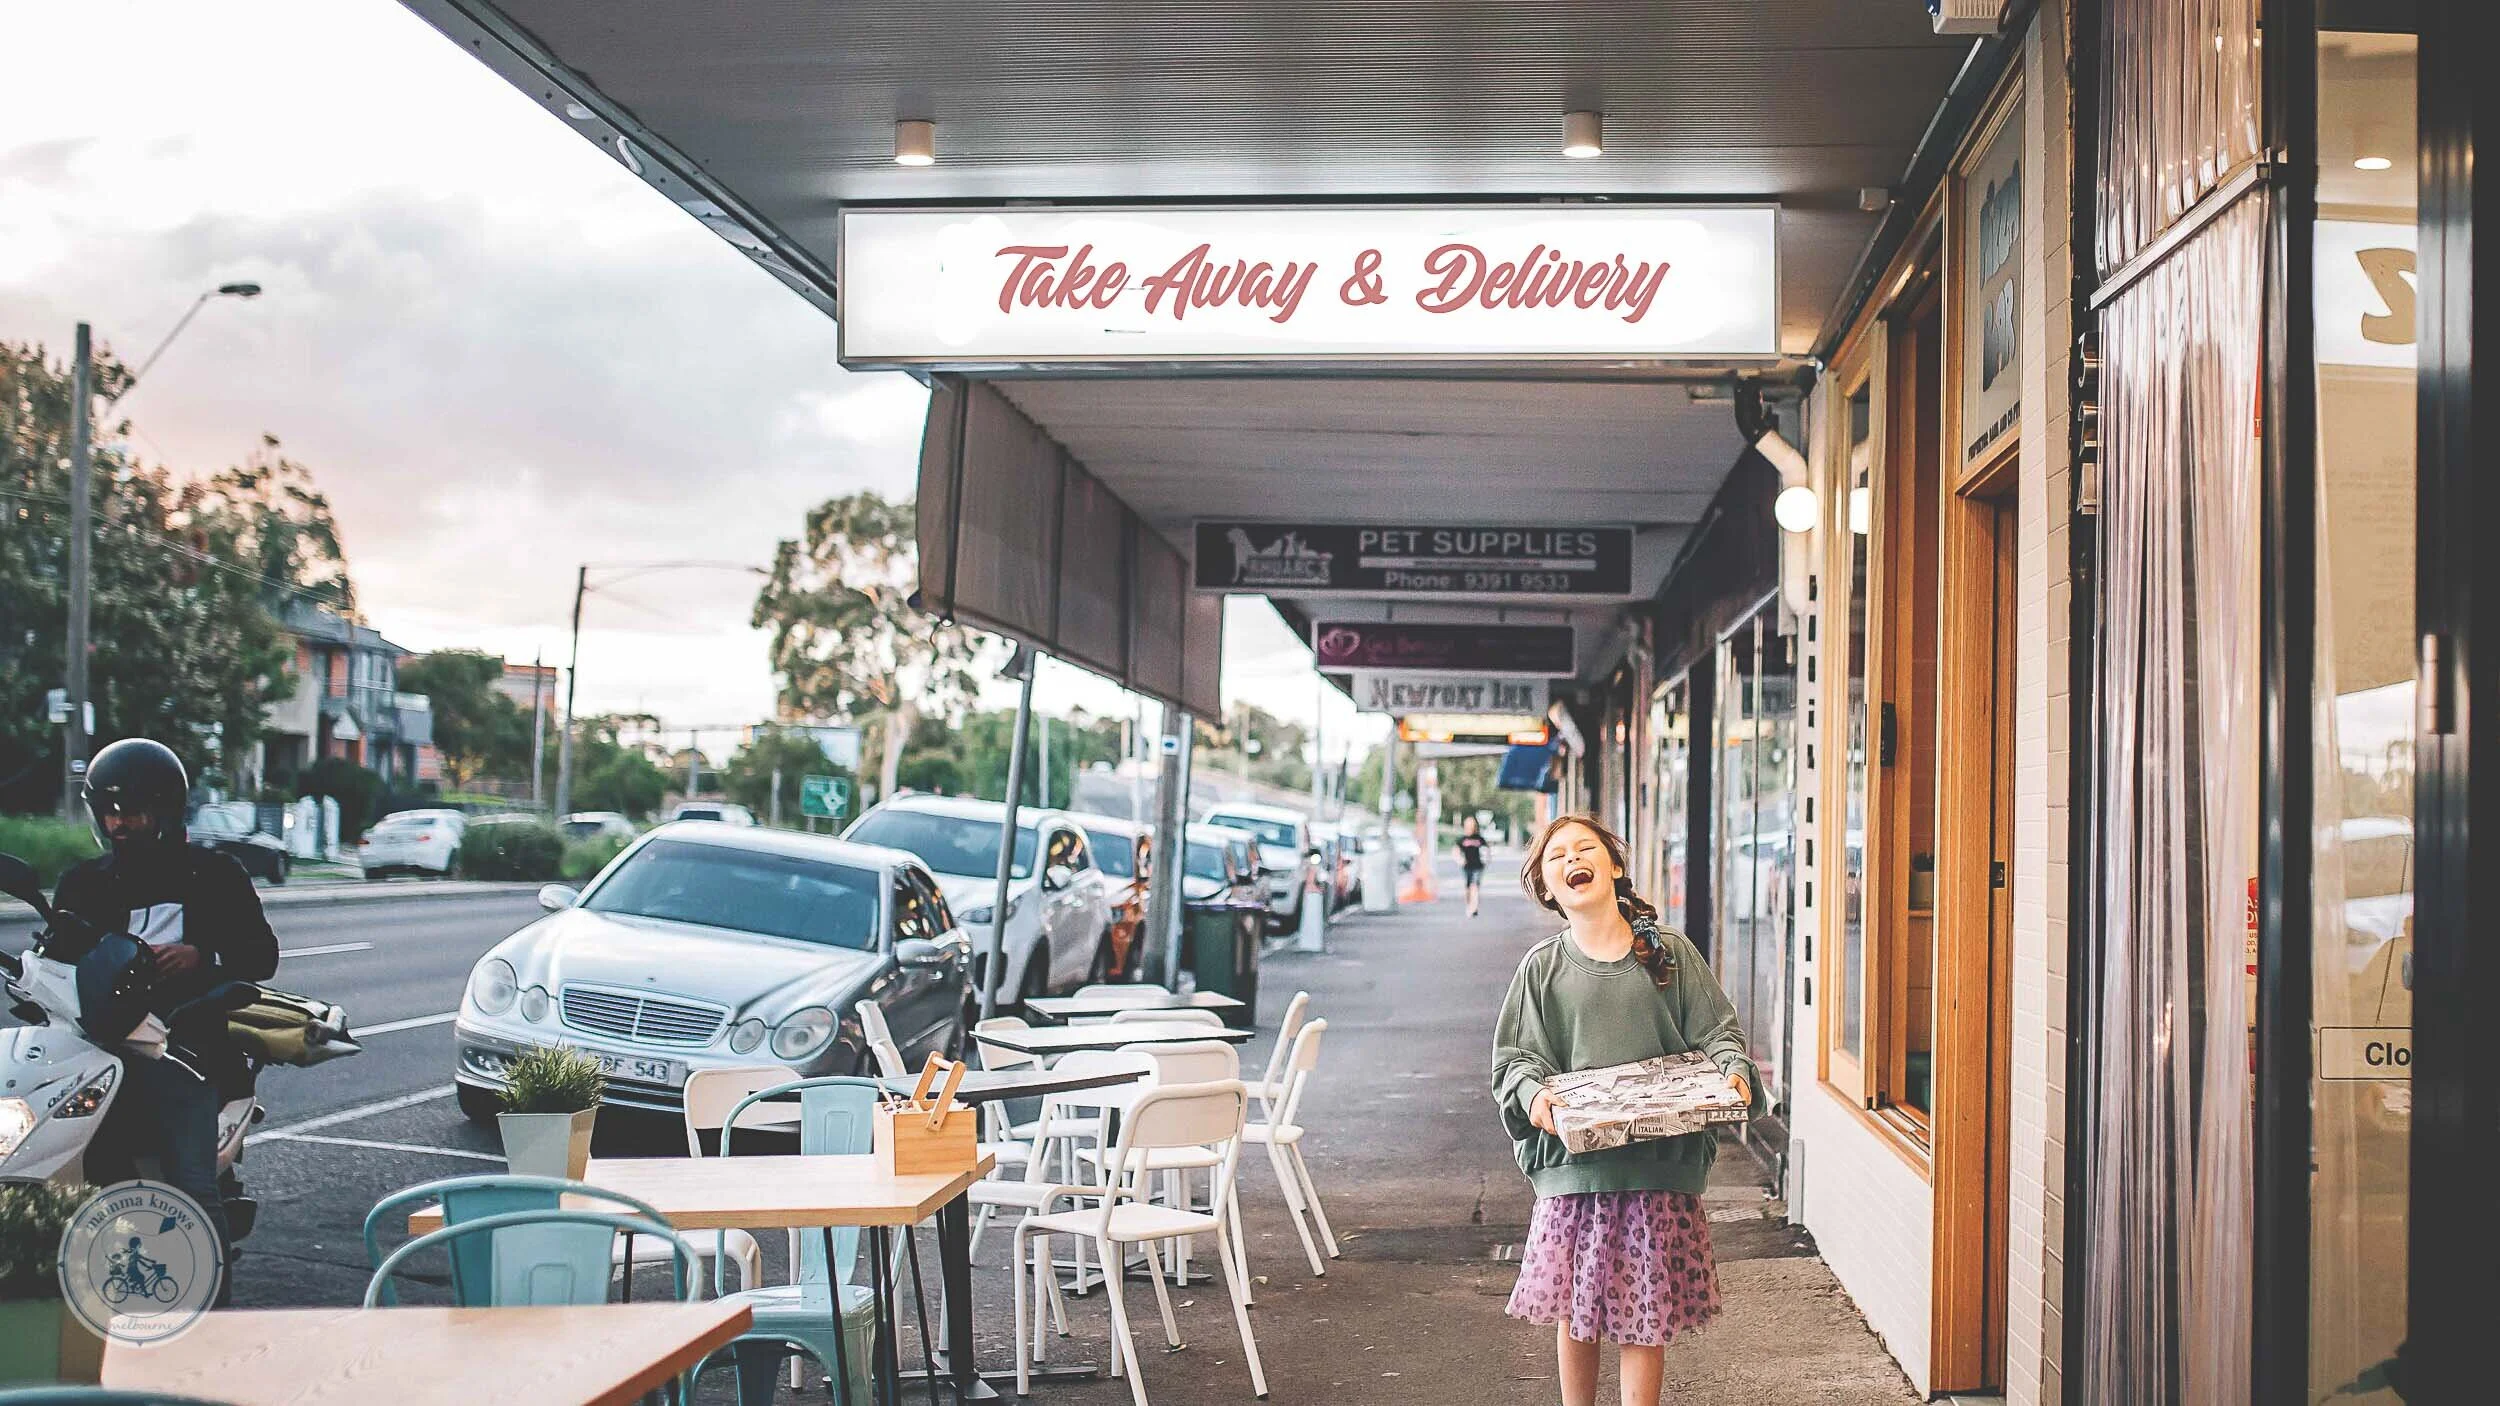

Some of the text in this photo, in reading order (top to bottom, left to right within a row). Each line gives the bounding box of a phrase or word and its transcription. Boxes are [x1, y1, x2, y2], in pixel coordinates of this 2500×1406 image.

[995, 243, 1671, 324] Take Away & Delivery
[1359, 530, 1597, 555] PET SUPPLIES
[1464, 573, 1511, 590] 9391
[1520, 574, 1570, 590] 9533
[1710, 1110, 1748, 1120] PIZZA
[1638, 1126, 1664, 1134] ITALIAN
